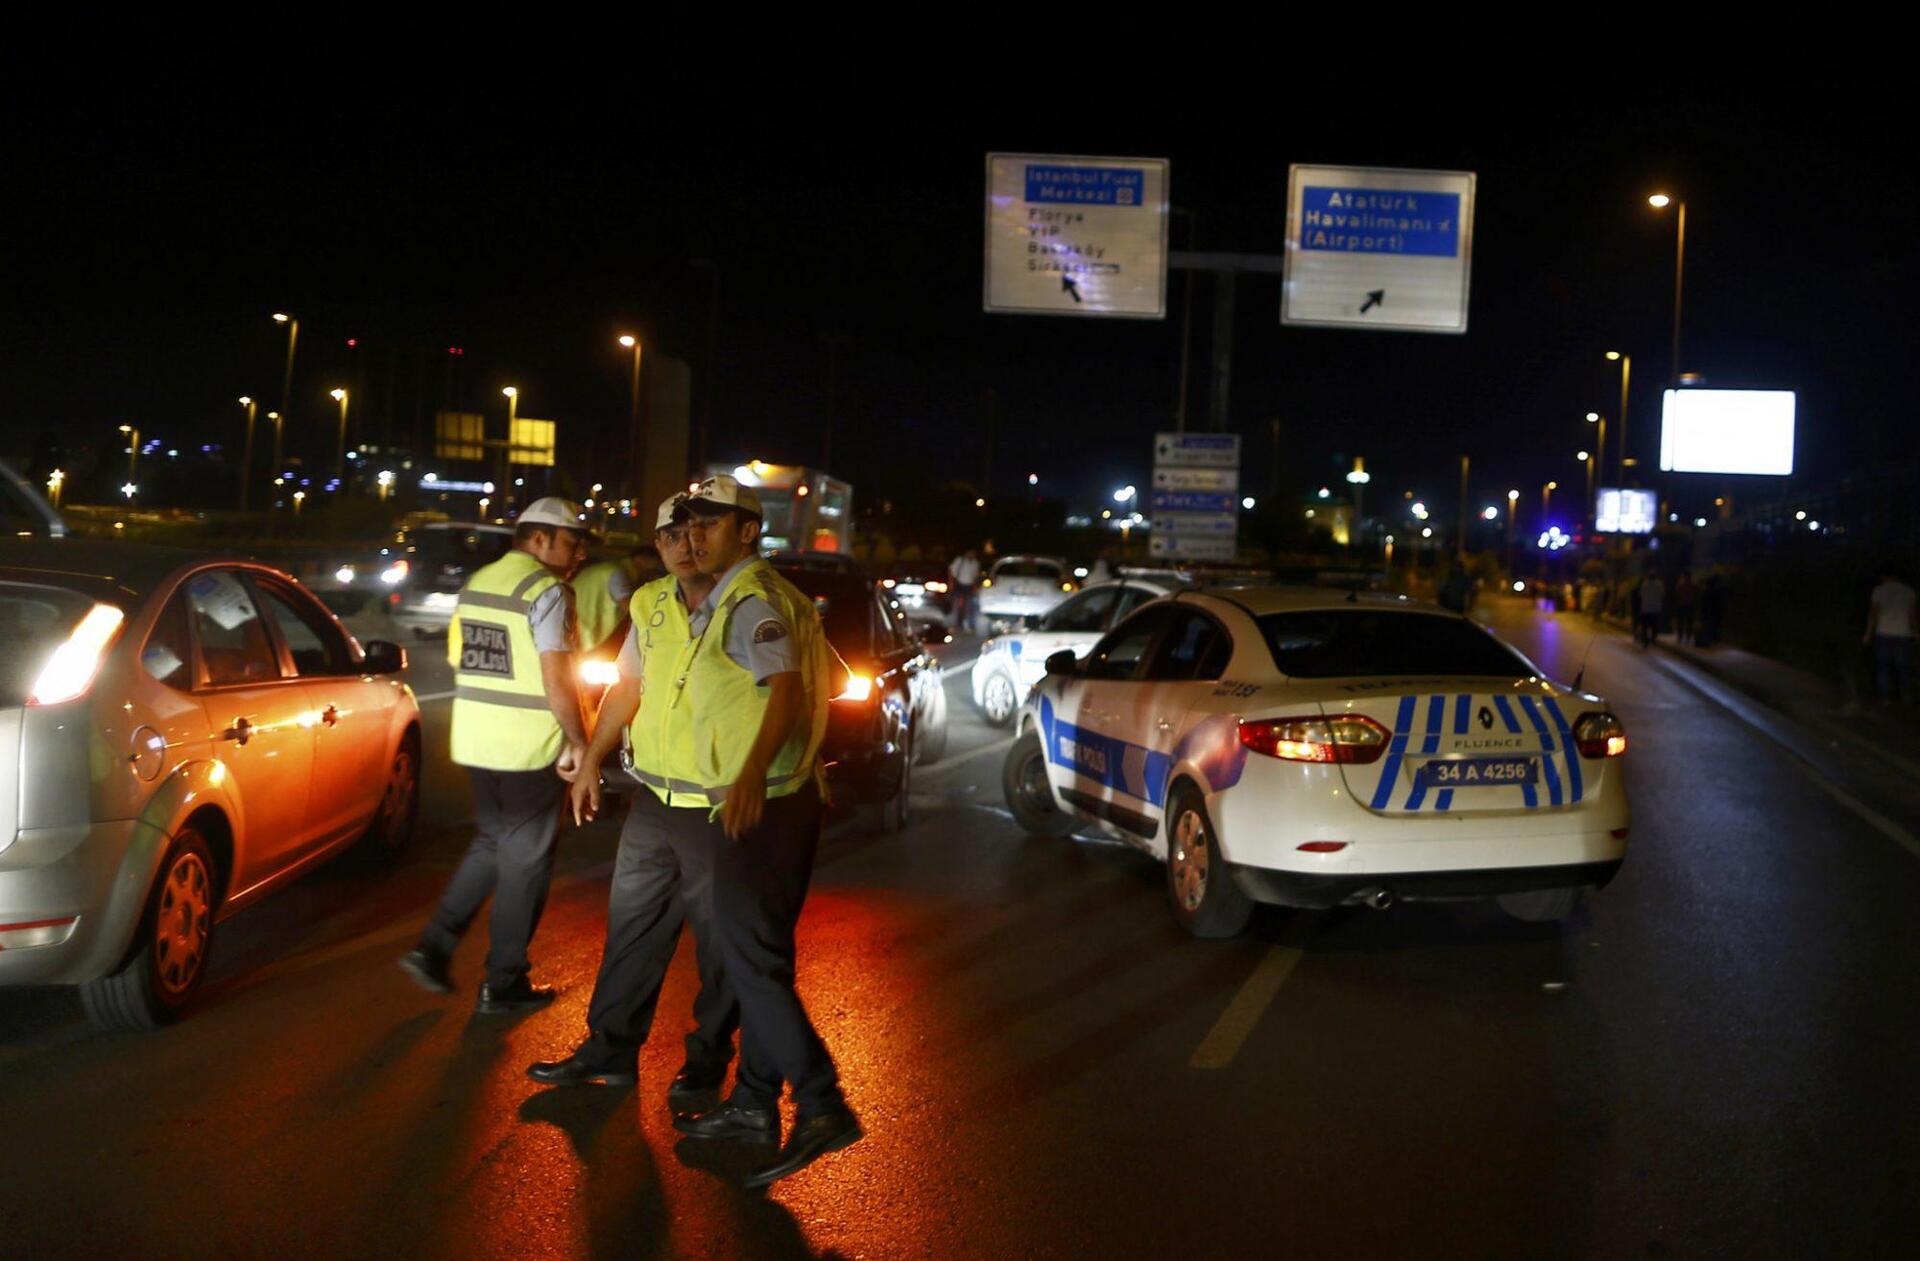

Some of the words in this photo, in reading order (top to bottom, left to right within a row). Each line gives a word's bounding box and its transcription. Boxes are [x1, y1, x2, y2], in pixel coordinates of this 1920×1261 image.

[1328, 192, 1417, 211] Atatürk
[1028, 207, 1084, 225] Florya
[1305, 231, 1403, 251] (Airport)
[1454, 739, 1523, 749] FLUENCE
[1437, 762, 1460, 781] 34
[1465, 764, 1479, 780] A
[1483, 762, 1526, 779] 4256
